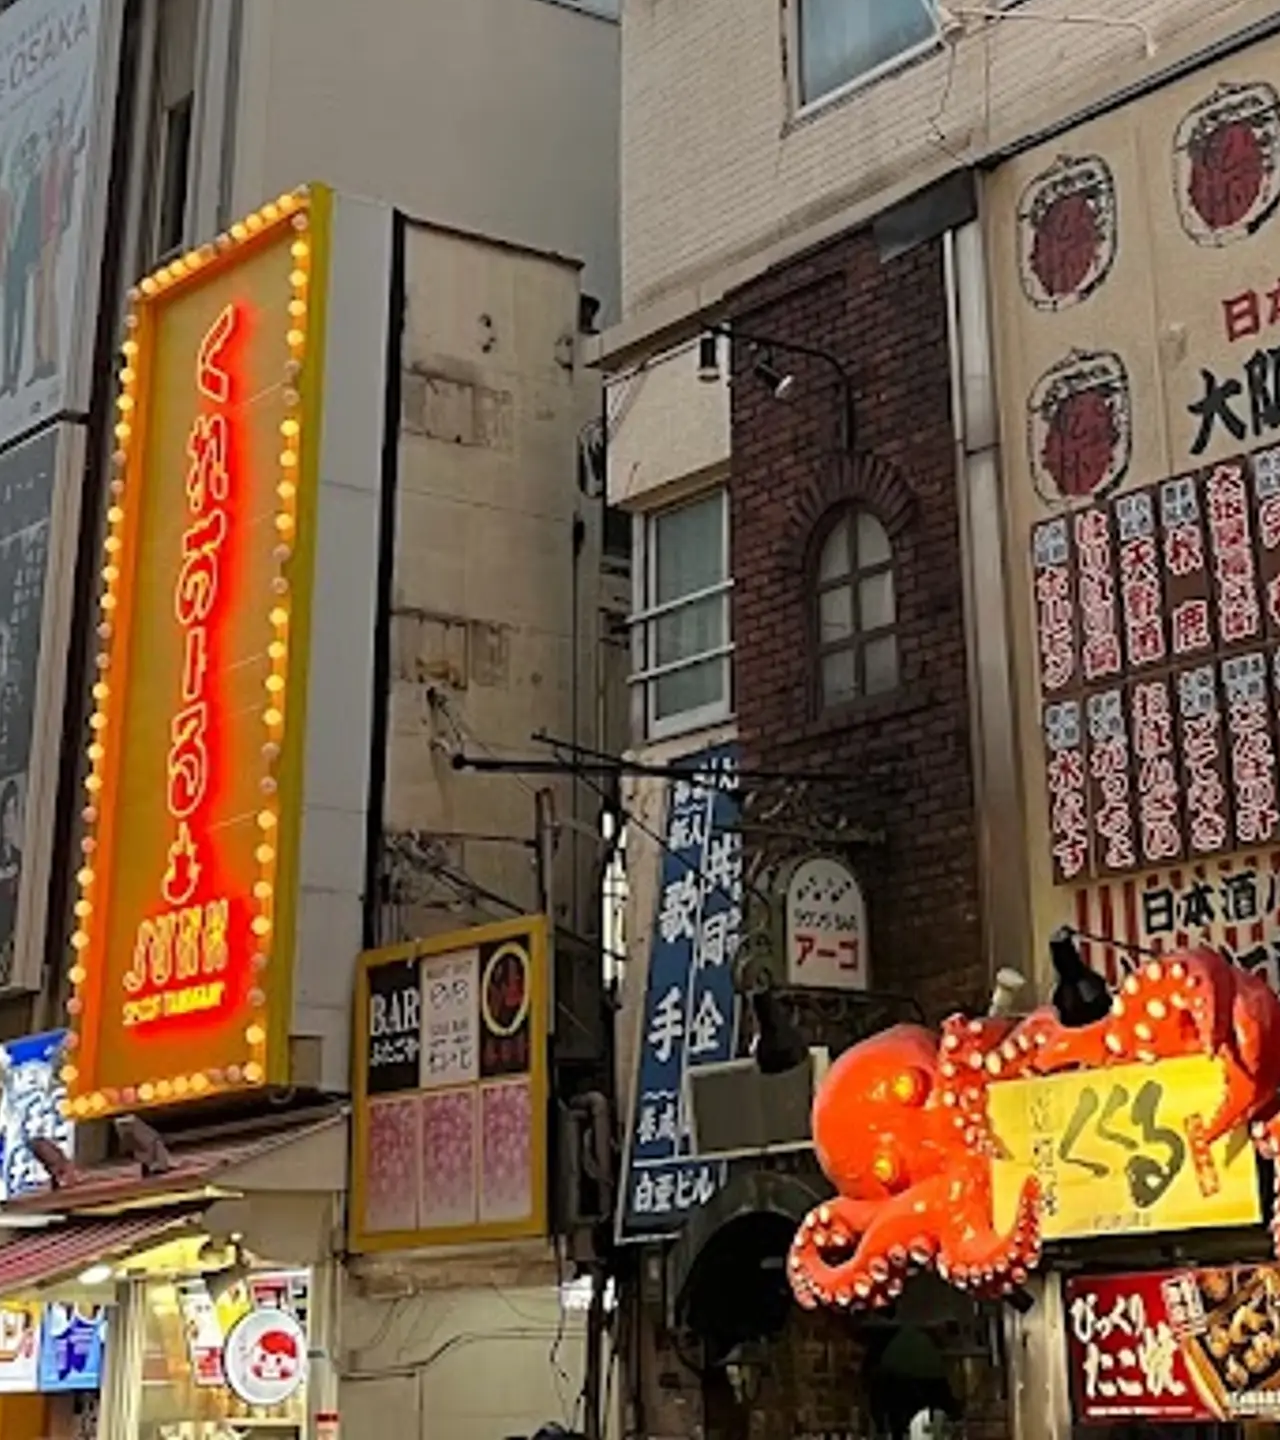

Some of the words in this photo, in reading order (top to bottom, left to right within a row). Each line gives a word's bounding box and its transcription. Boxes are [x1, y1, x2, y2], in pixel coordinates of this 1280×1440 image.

[9, 3, 90, 91] OSAKA
[794, 934, 860, 970] アーゴ
[370, 987, 420, 1038] BAR
[1058, 1080, 1187, 1210] くくる
[632, 1167, 716, 1215] 白亜ビル
[1071, 1293, 1146, 1344] びっくり
[1083, 1320, 1188, 1399] たこ焼
